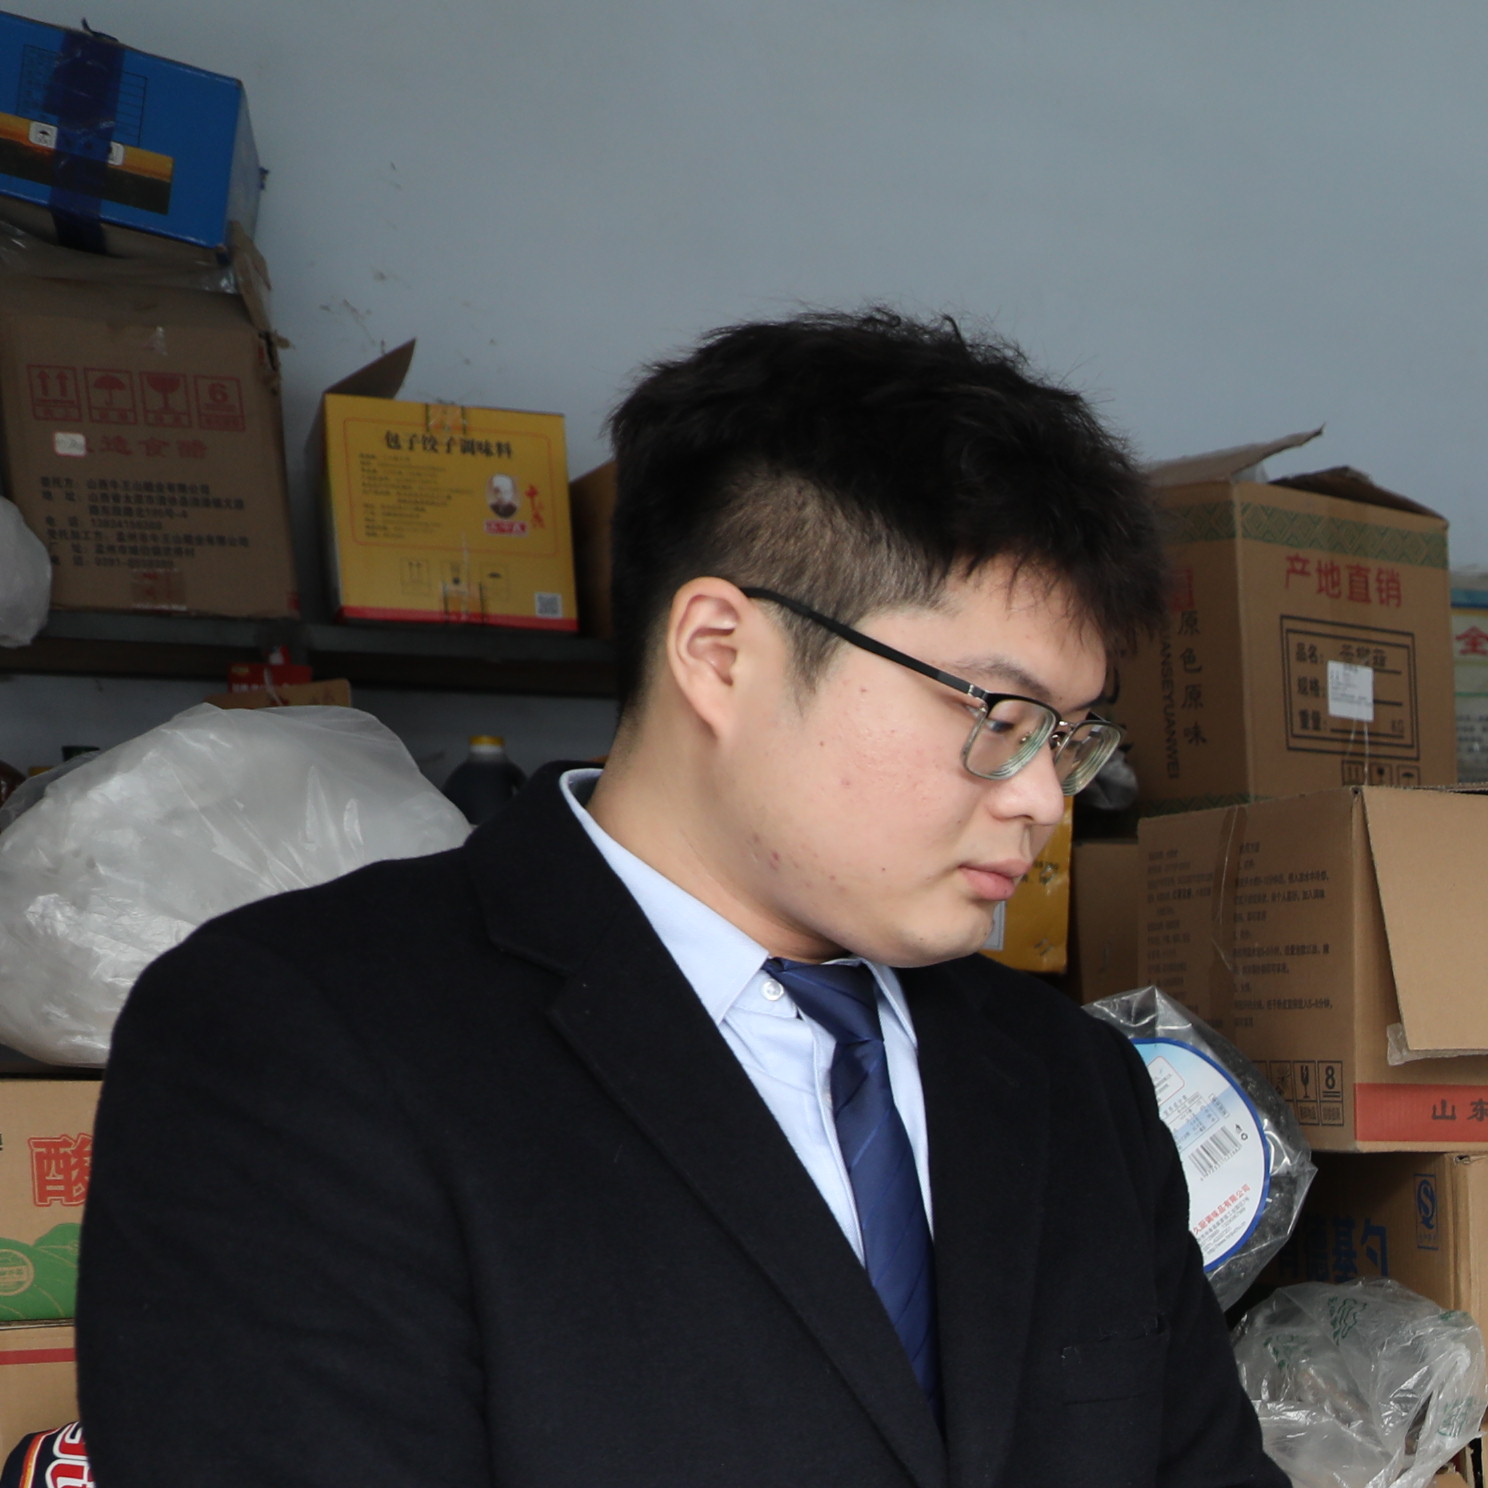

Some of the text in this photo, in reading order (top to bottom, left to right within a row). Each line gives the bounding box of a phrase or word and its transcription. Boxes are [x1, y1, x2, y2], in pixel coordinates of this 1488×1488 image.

[384, 429, 514, 460] 包子饺子调味料
[1284, 553, 1403, 608] 产地直销
[1178, 610, 1207, 747] 原色原味
